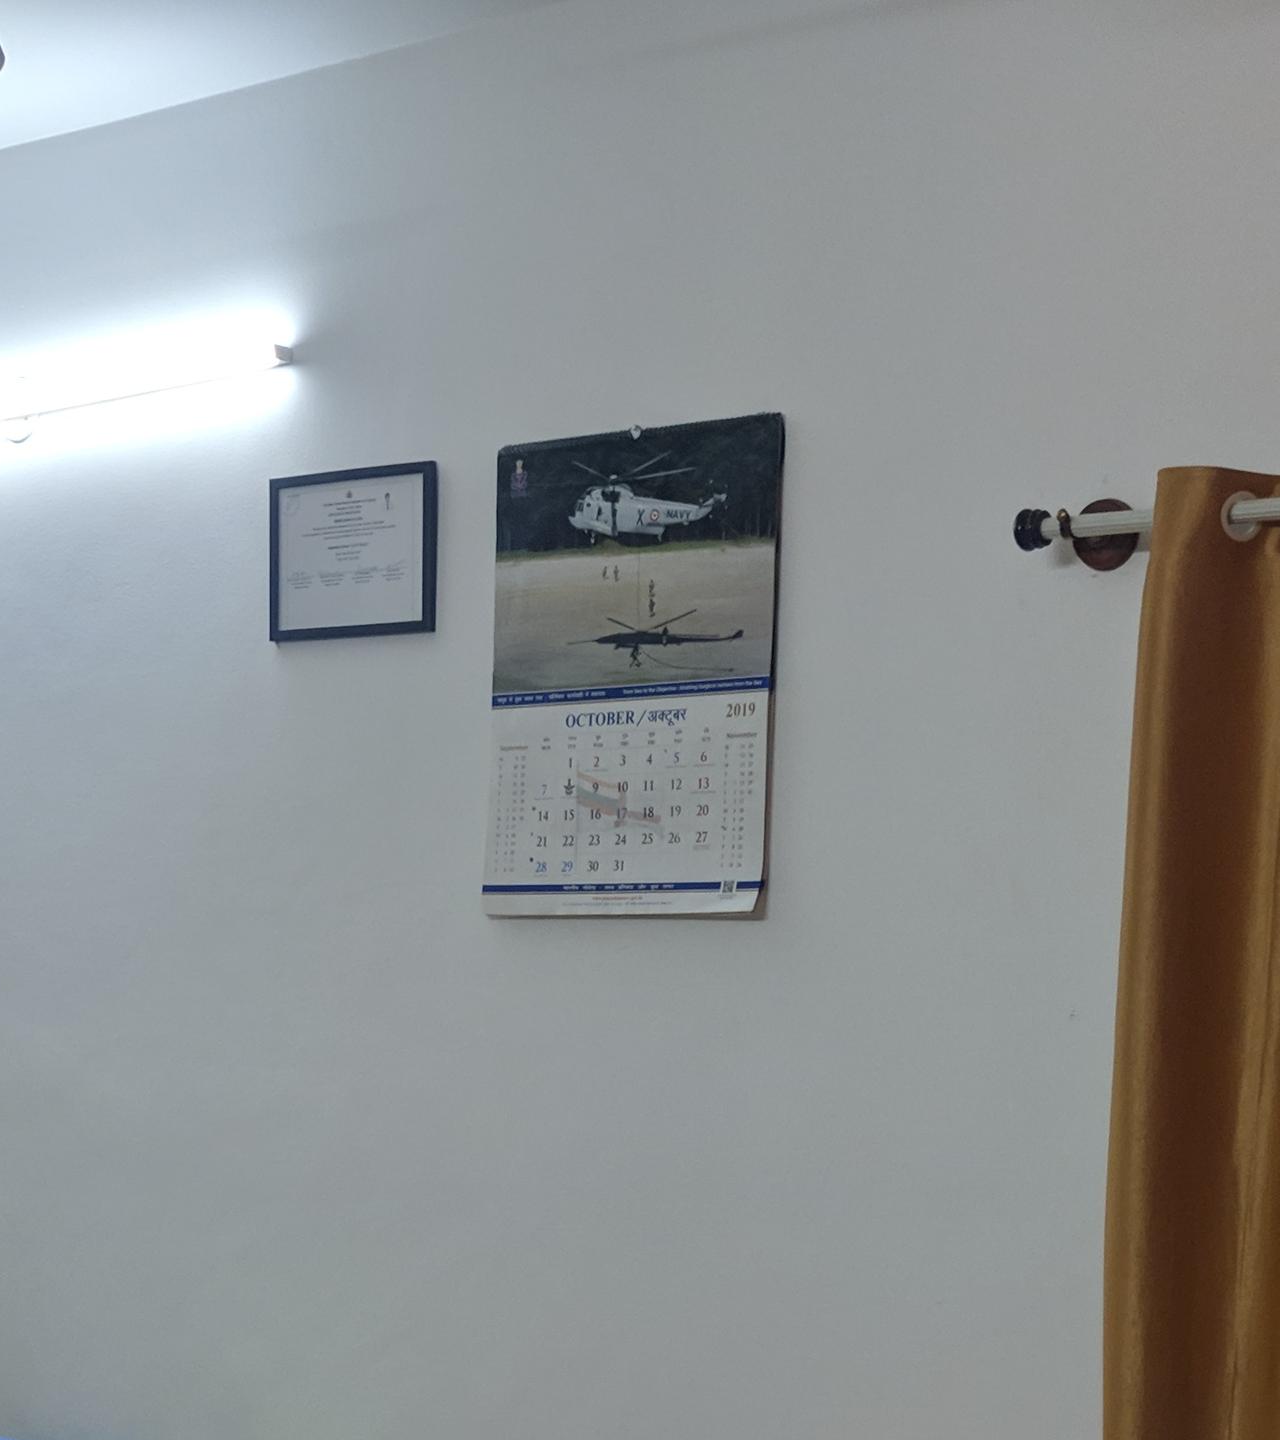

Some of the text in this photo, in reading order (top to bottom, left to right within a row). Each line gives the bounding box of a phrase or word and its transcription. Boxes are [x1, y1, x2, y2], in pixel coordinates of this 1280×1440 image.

[666, 510, 691, 519] NAVY
[726, 703, 755, 718] 2019
[593, 756, 600, 767] 2
[620, 755, 626, 766] 3
[646, 753, 653, 765] 4
[673, 752, 680, 763] 5
[700, 751, 707, 762] 6
[592, 782, 599, 793] 9
[618, 781, 628, 792] 10
[644, 780, 653, 791] 11
[671, 779, 682, 790] 12
[698, 778, 709, 789] 13
[538, 805, 709, 821] 14 15 16 17 18 19 20
[537, 832, 708, 847] 21 22 23 24 25 26 27
[536, 860, 624, 872] 28 29 30 31
